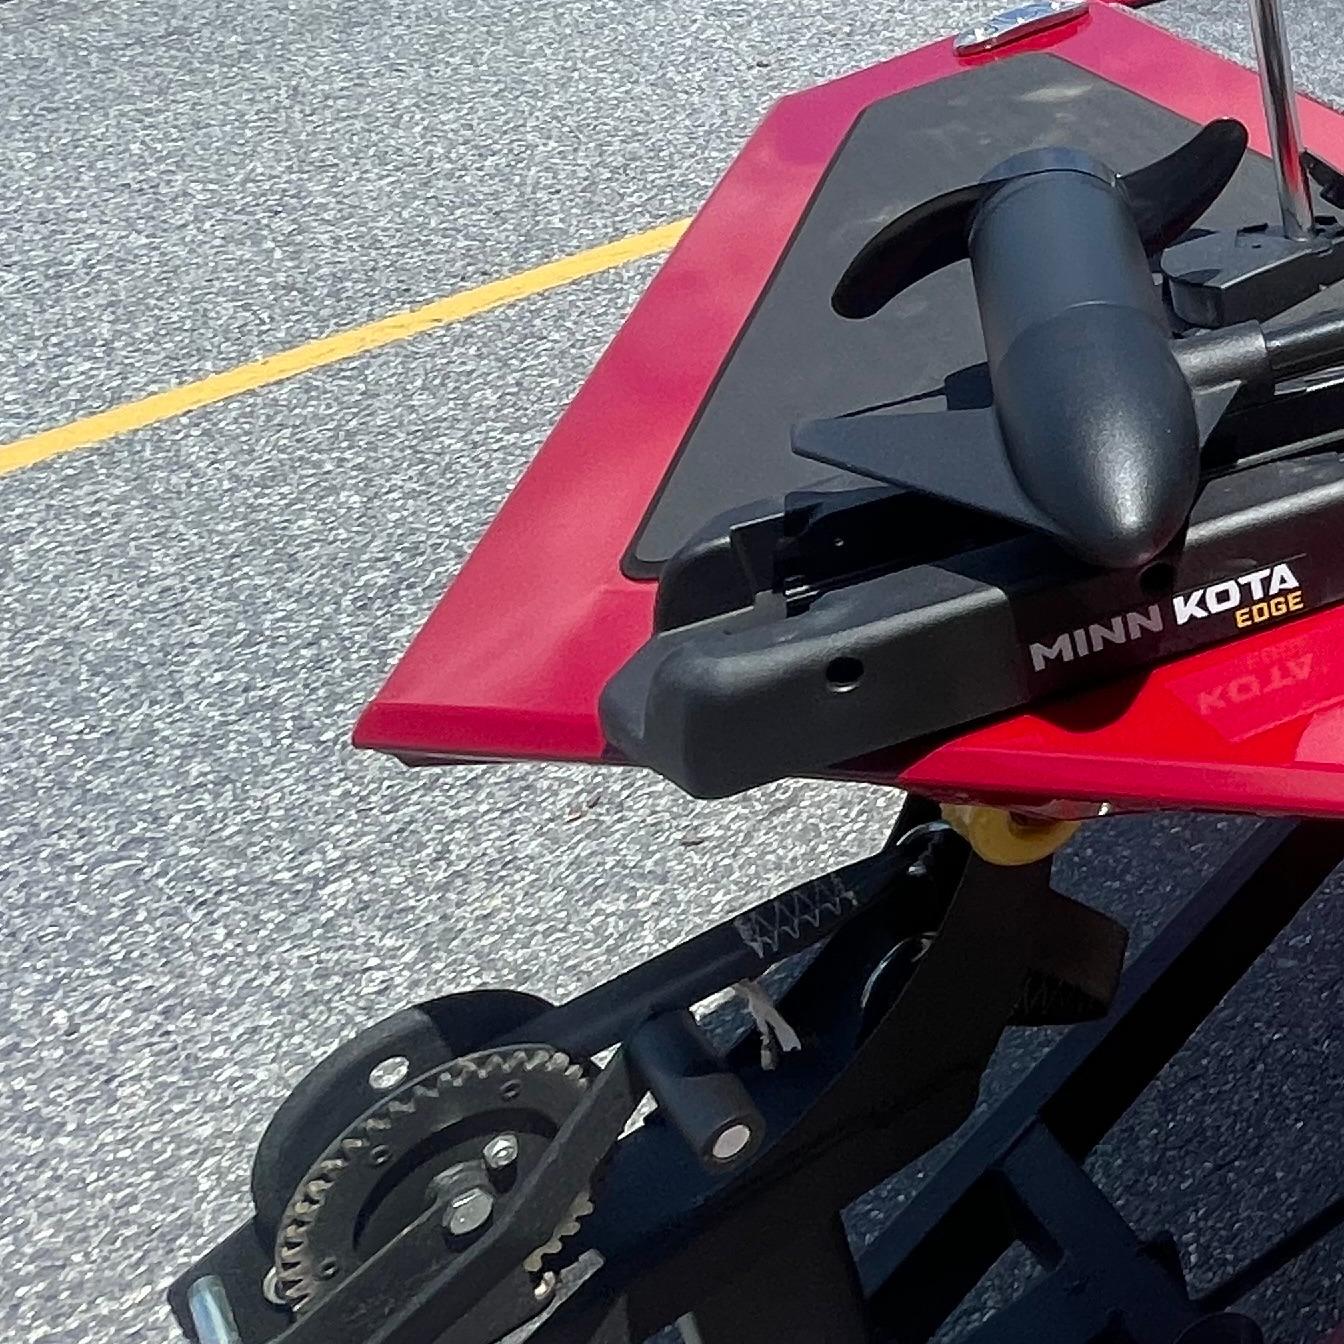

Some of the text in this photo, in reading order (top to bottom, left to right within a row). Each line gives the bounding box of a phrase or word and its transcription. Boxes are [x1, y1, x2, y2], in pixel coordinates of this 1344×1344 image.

[1029, 563, 1299, 672] MINN KOTA
[1235, 590, 1304, 628] EDGE
